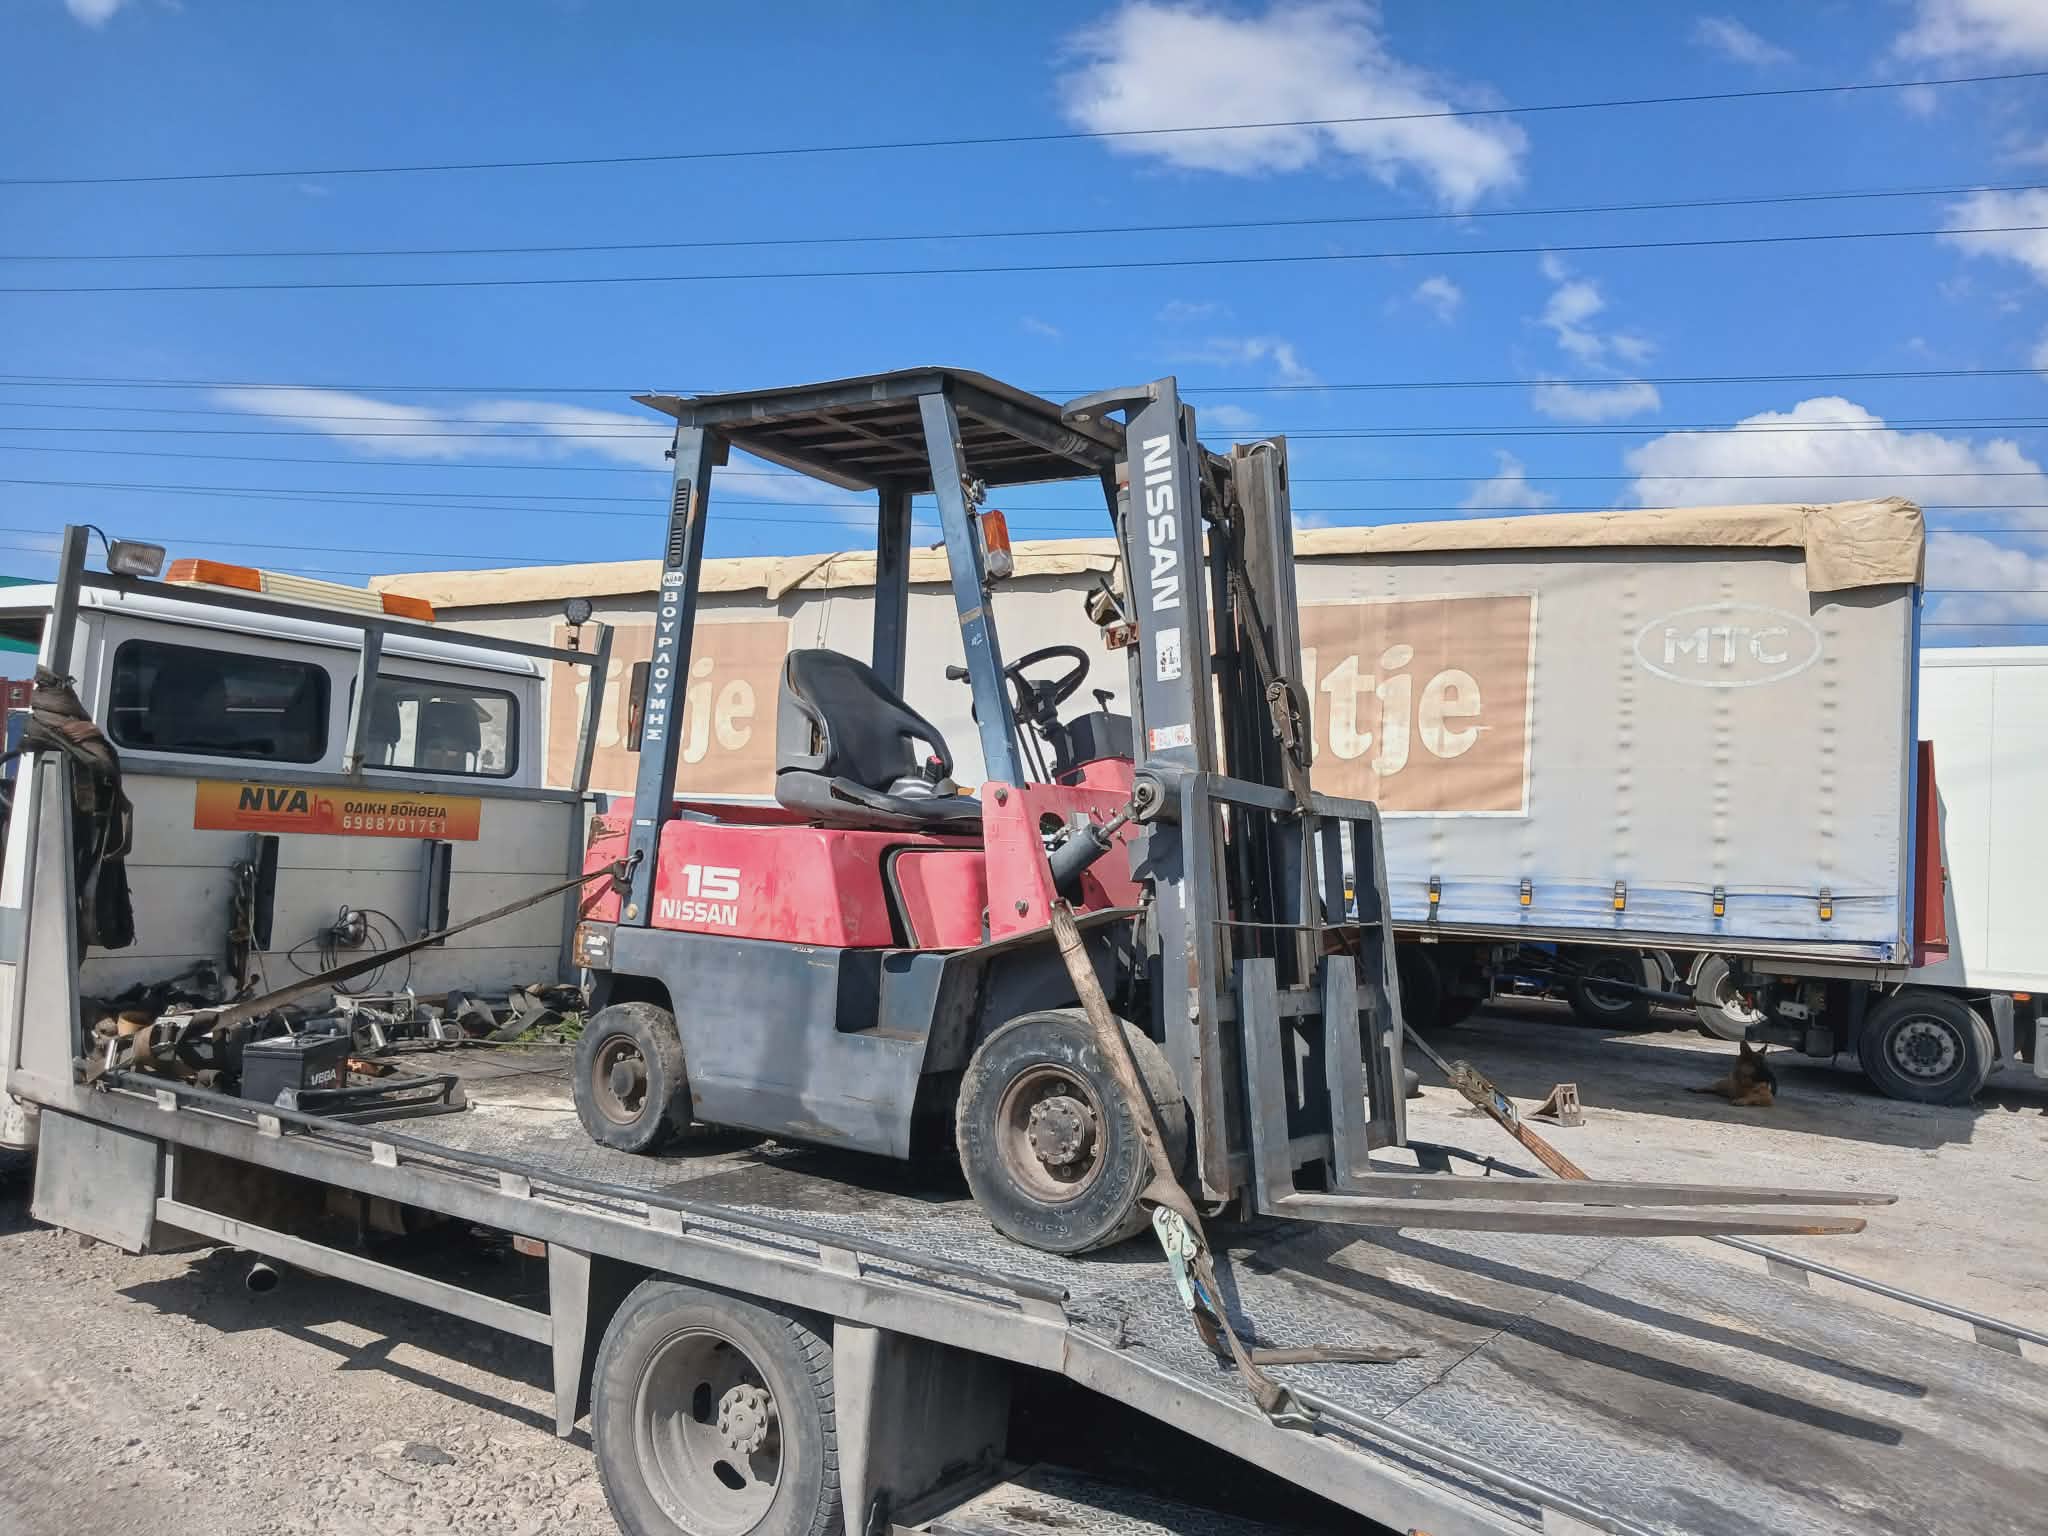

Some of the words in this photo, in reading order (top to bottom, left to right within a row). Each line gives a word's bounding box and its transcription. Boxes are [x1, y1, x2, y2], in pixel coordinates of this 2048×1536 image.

[1143, 434, 1180, 611] NISSAN
[1663, 626, 1787, 664] MTC
[238, 786, 308, 813] NVA
[344, 801, 387, 815] ΟΔΙΚΗ
[390, 803, 447, 818] ΒΟΗΘΕΙΑ
[681, 864, 741, 900] 15
[660, 898, 738, 926] NISSAN
[311, 1068, 337, 1086] VEGA
